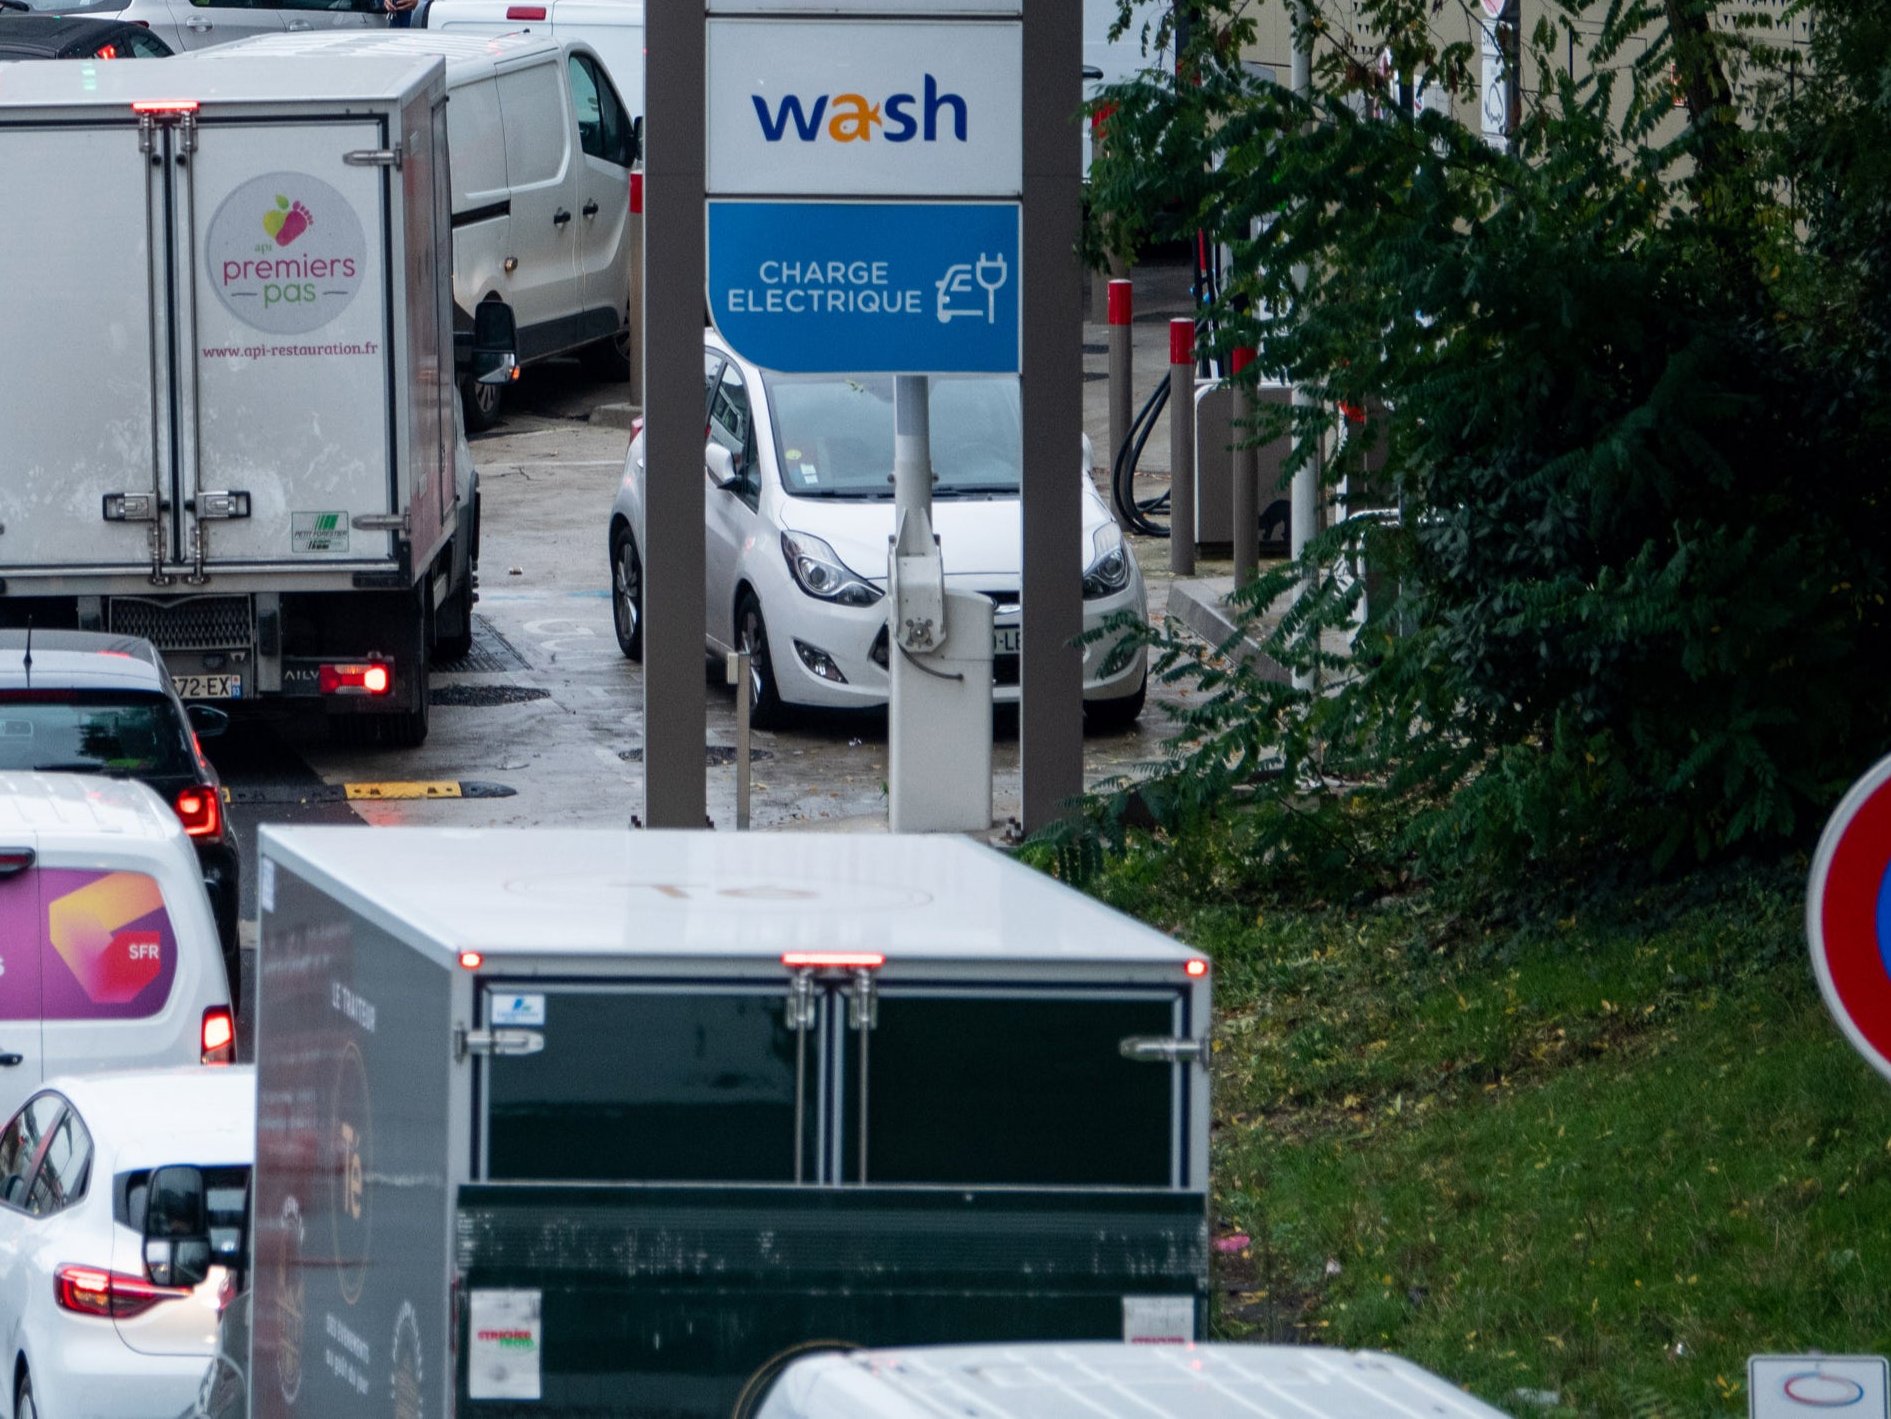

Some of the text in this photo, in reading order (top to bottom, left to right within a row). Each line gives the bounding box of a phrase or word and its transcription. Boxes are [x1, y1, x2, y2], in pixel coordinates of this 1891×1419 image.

[751, 73, 968, 143] wash
[254, 242, 273, 255] api
[223, 253, 356, 286] premiers
[759, 261, 889, 285] CHARGE
[264, 283, 316, 309] pas
[728, 290, 922, 314] ELECTRIQUE
[203, 342, 378, 360] www.api-restauration.fr
[129, 944, 160, 959] SFR
